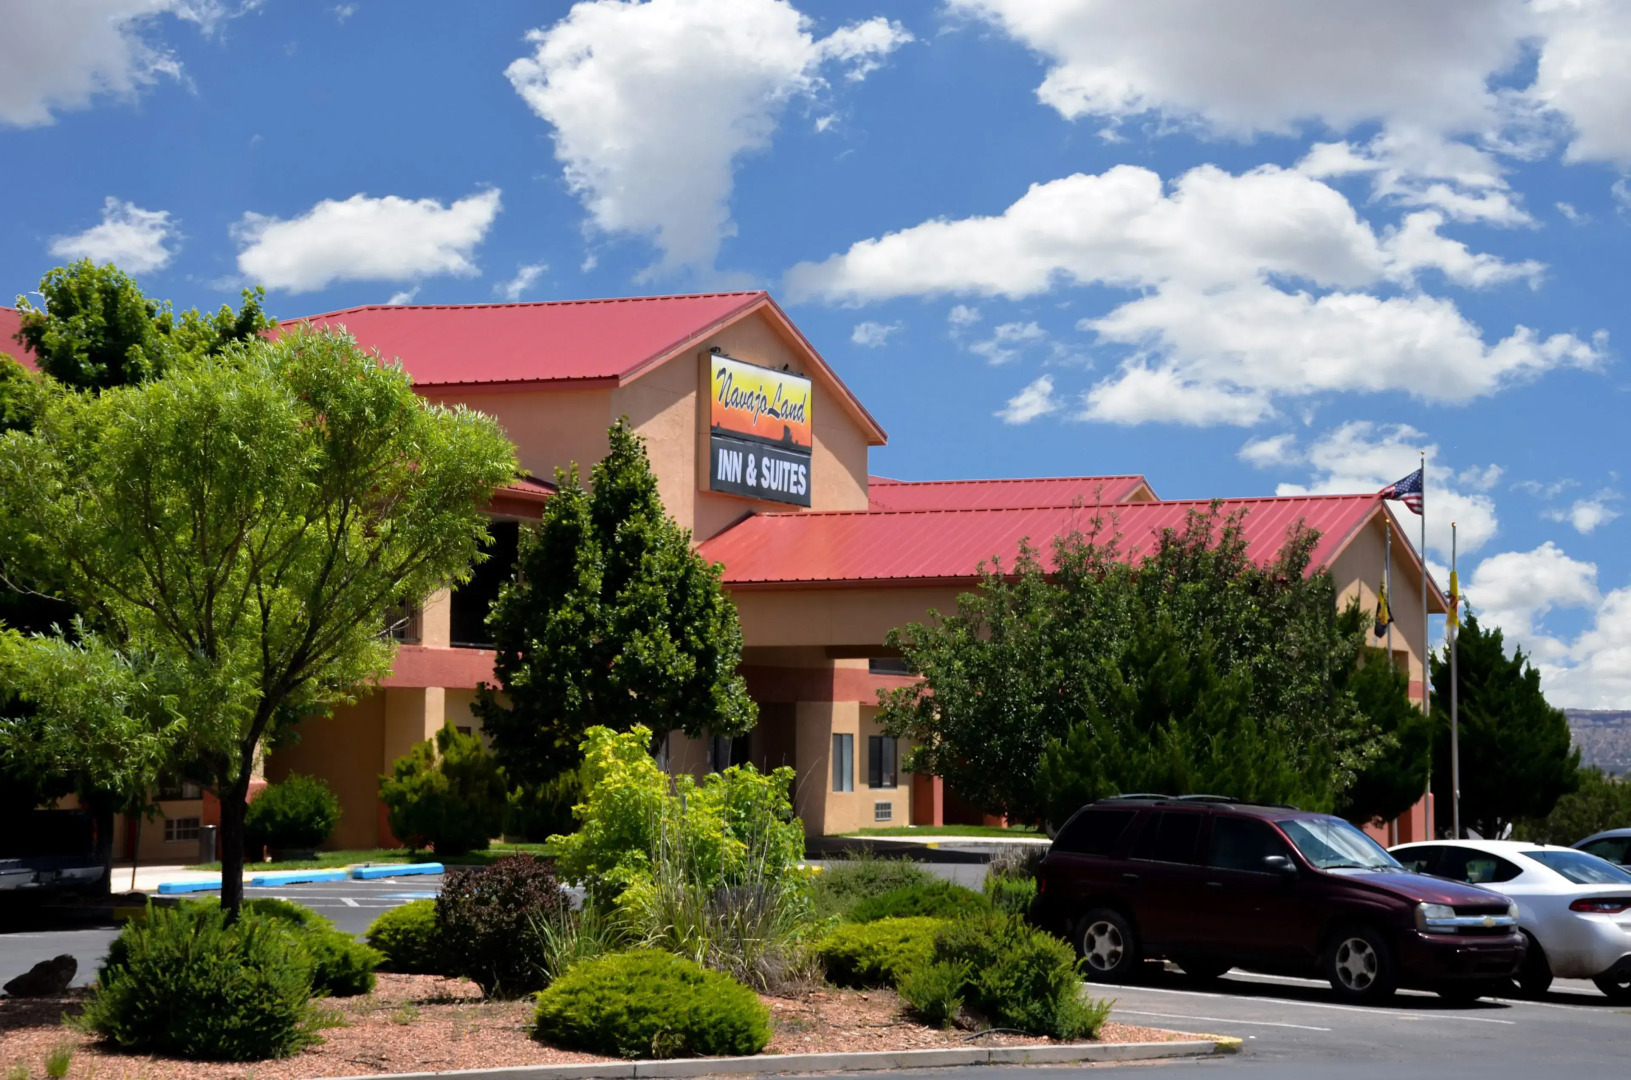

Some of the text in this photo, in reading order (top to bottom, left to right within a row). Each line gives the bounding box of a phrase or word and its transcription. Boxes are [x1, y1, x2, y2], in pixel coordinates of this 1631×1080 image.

[716, 367, 807, 426] Navajo Land
[717, 448, 807, 496] INN & SUITES
